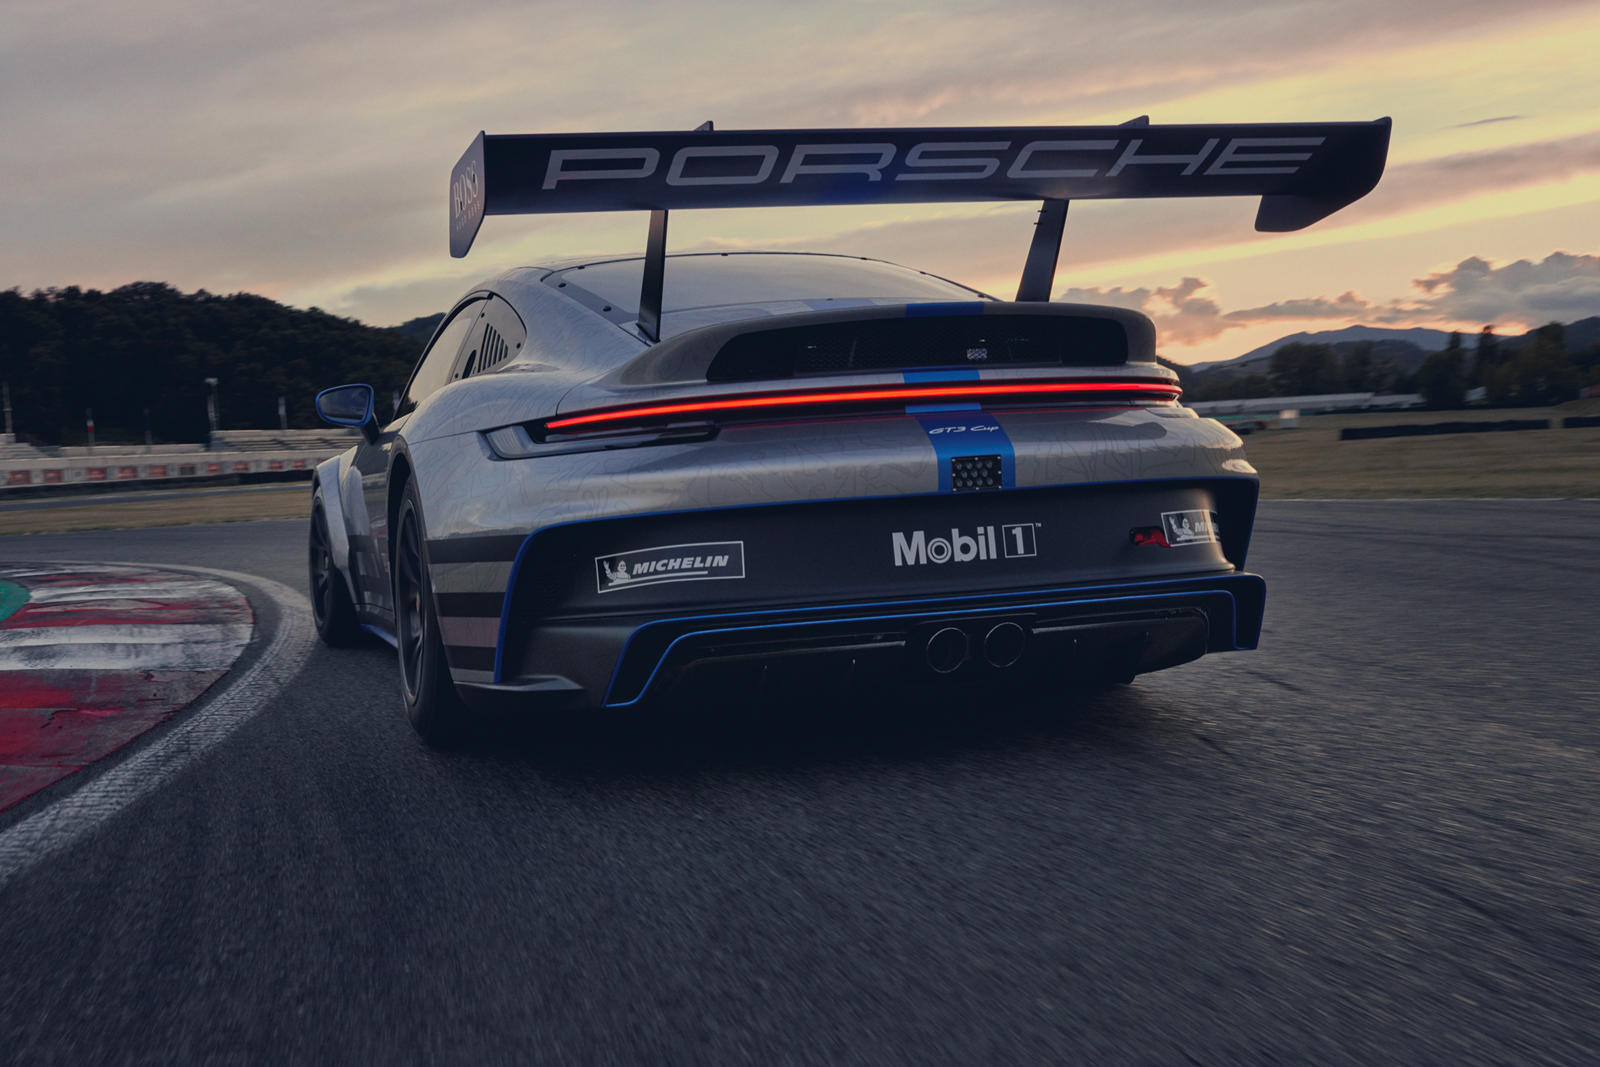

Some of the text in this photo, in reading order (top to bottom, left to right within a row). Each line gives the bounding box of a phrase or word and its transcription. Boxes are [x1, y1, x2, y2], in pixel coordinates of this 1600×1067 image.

[542, 136, 1326, 190] PORSCHE
[453, 160, 479, 218] BOSS
[929, 426, 966, 434] GT3
[632, 555, 729, 575] MICHELIN
[892, 525, 997, 566] Mobil
